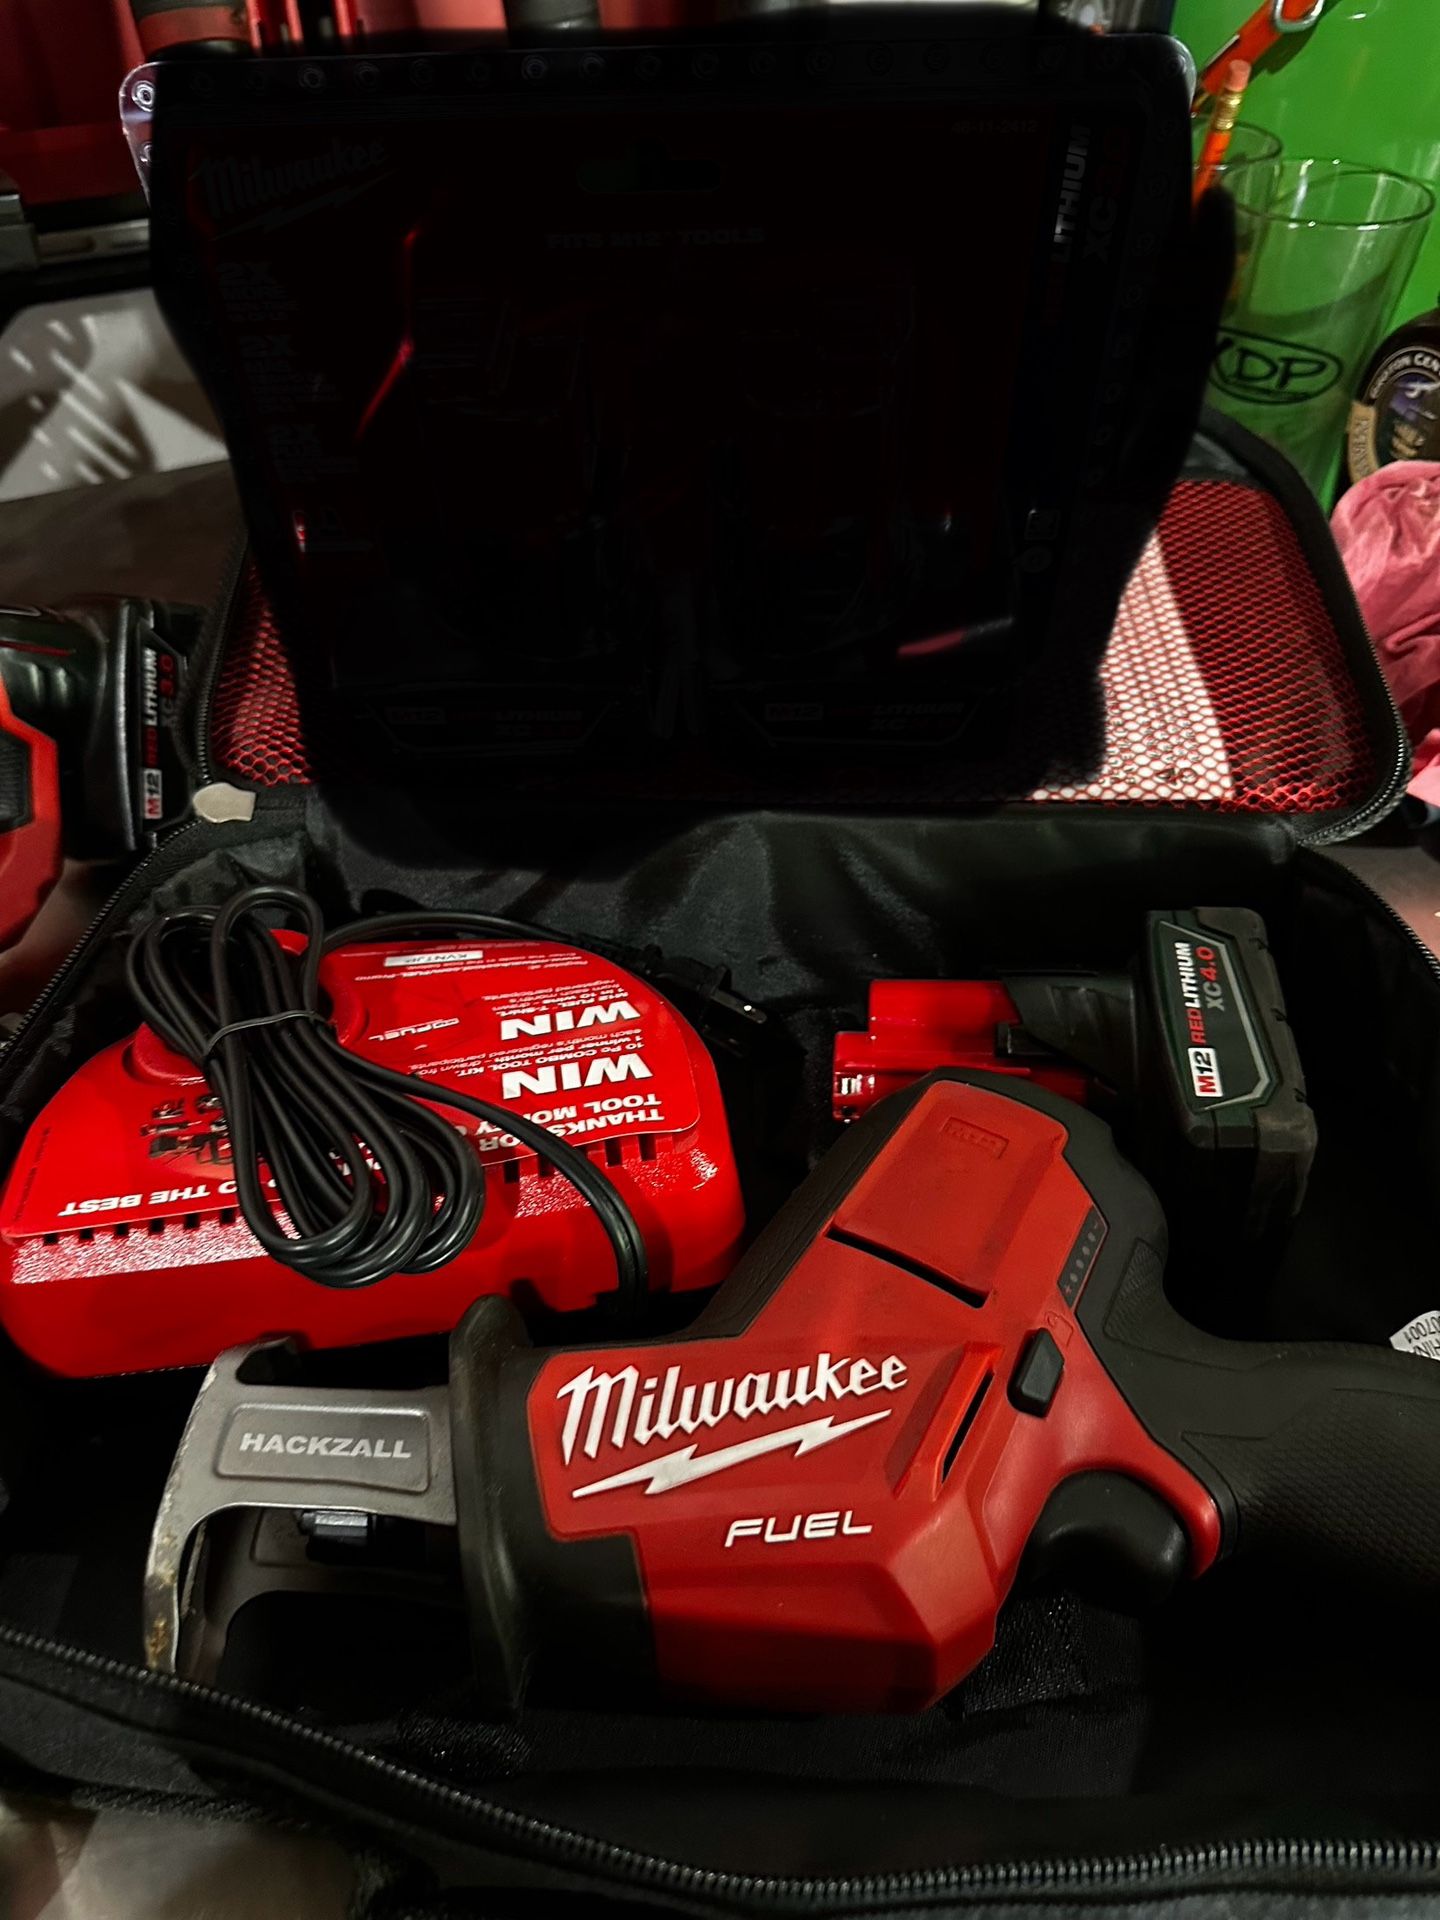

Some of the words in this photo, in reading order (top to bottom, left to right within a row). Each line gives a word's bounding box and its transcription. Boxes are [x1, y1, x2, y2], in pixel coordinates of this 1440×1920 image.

[188, 135, 390, 219] Milwaukee
[147, 772, 160, 815] M12
[1195, 946, 1226, 1013] XC4.0
[1174, 941, 1208, 1046] REDLITHIUM
[500, 1000, 641, 1041] WIN
[494, 1050, 544, 1063] month
[535, 1049, 597, 1064] COMBO
[547, 1044, 575, 1054] per
[577, 1037, 632, 1050] winner
[625, 1042, 644, 1050] 10
[454, 1066, 485, 1077] KIT.
[487, 1059, 532, 1071] TOOL
[501, 1052, 653, 1100] WIN
[1194, 1050, 1218, 1094] M12
[583, 1093, 662, 1113] TOOL
[474, 1105, 578, 1136] MOY
[545, 1108, 665, 1137] THANKS
[478, 1133, 524, 1152] OR
[57, 1193, 144, 1217] BEST
[148, 1184, 210, 1205] THE
[556, 1352, 908, 1467] Milwaukee
[238, 1432, 412, 1459] HACKZALL
[724, 1510, 873, 1548] FUEL
